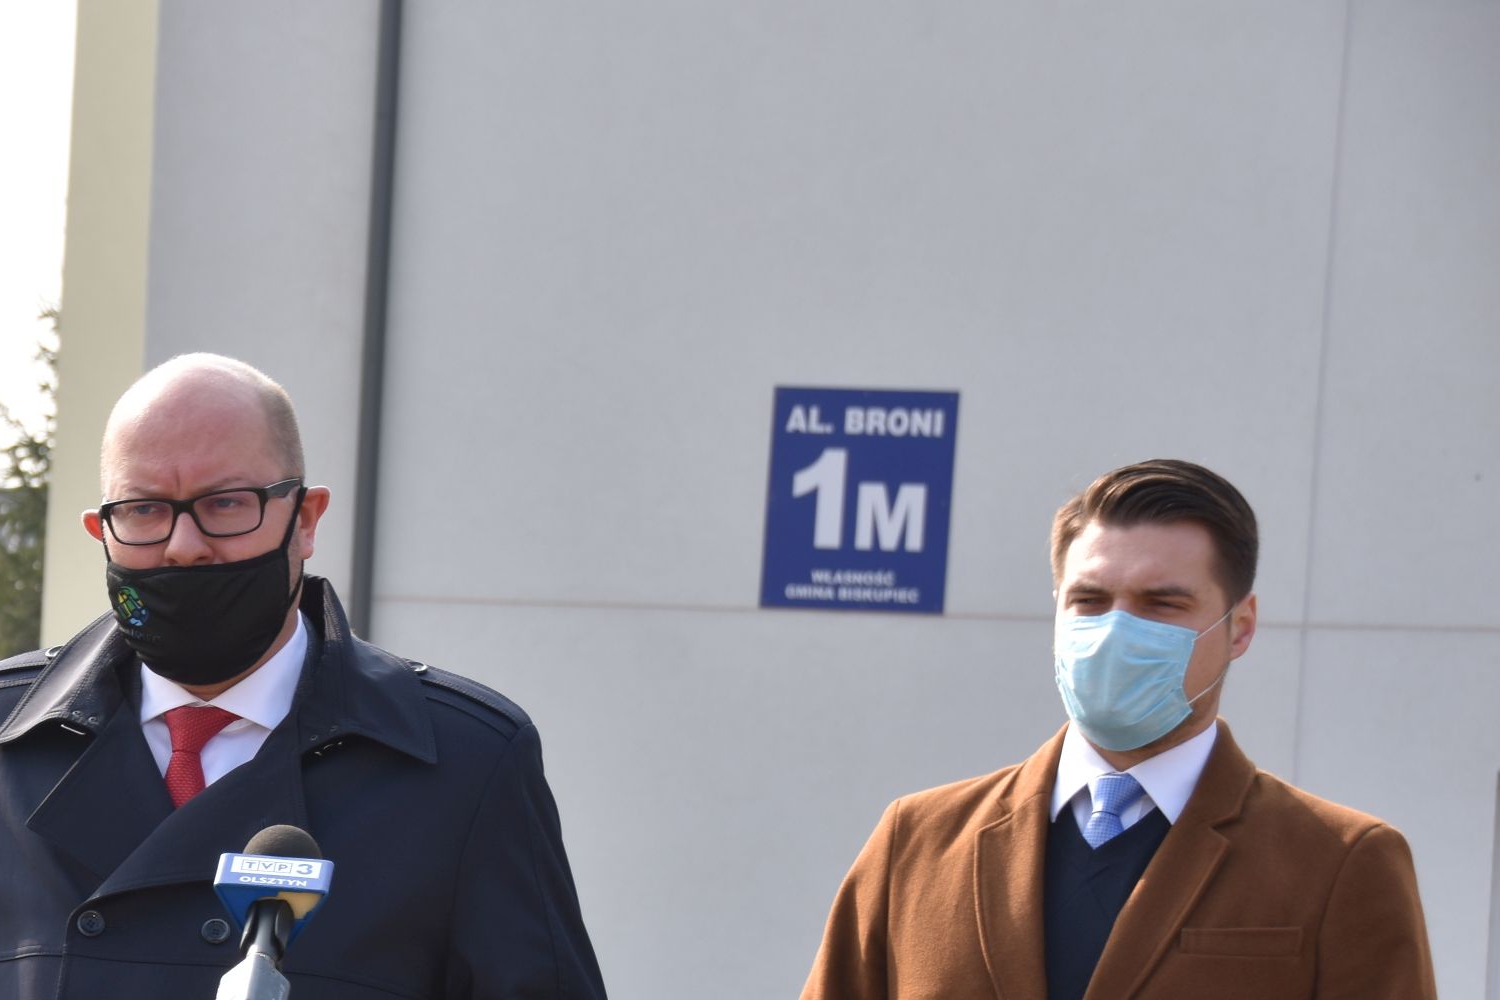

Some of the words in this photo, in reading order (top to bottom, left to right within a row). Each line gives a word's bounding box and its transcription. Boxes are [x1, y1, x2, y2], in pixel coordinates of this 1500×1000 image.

[786, 405, 834, 434] AL.
[844, 407, 945, 437] BRONI
[785, 583, 835, 601] GMINA
[239, 875, 307, 887] OLSZTYN
